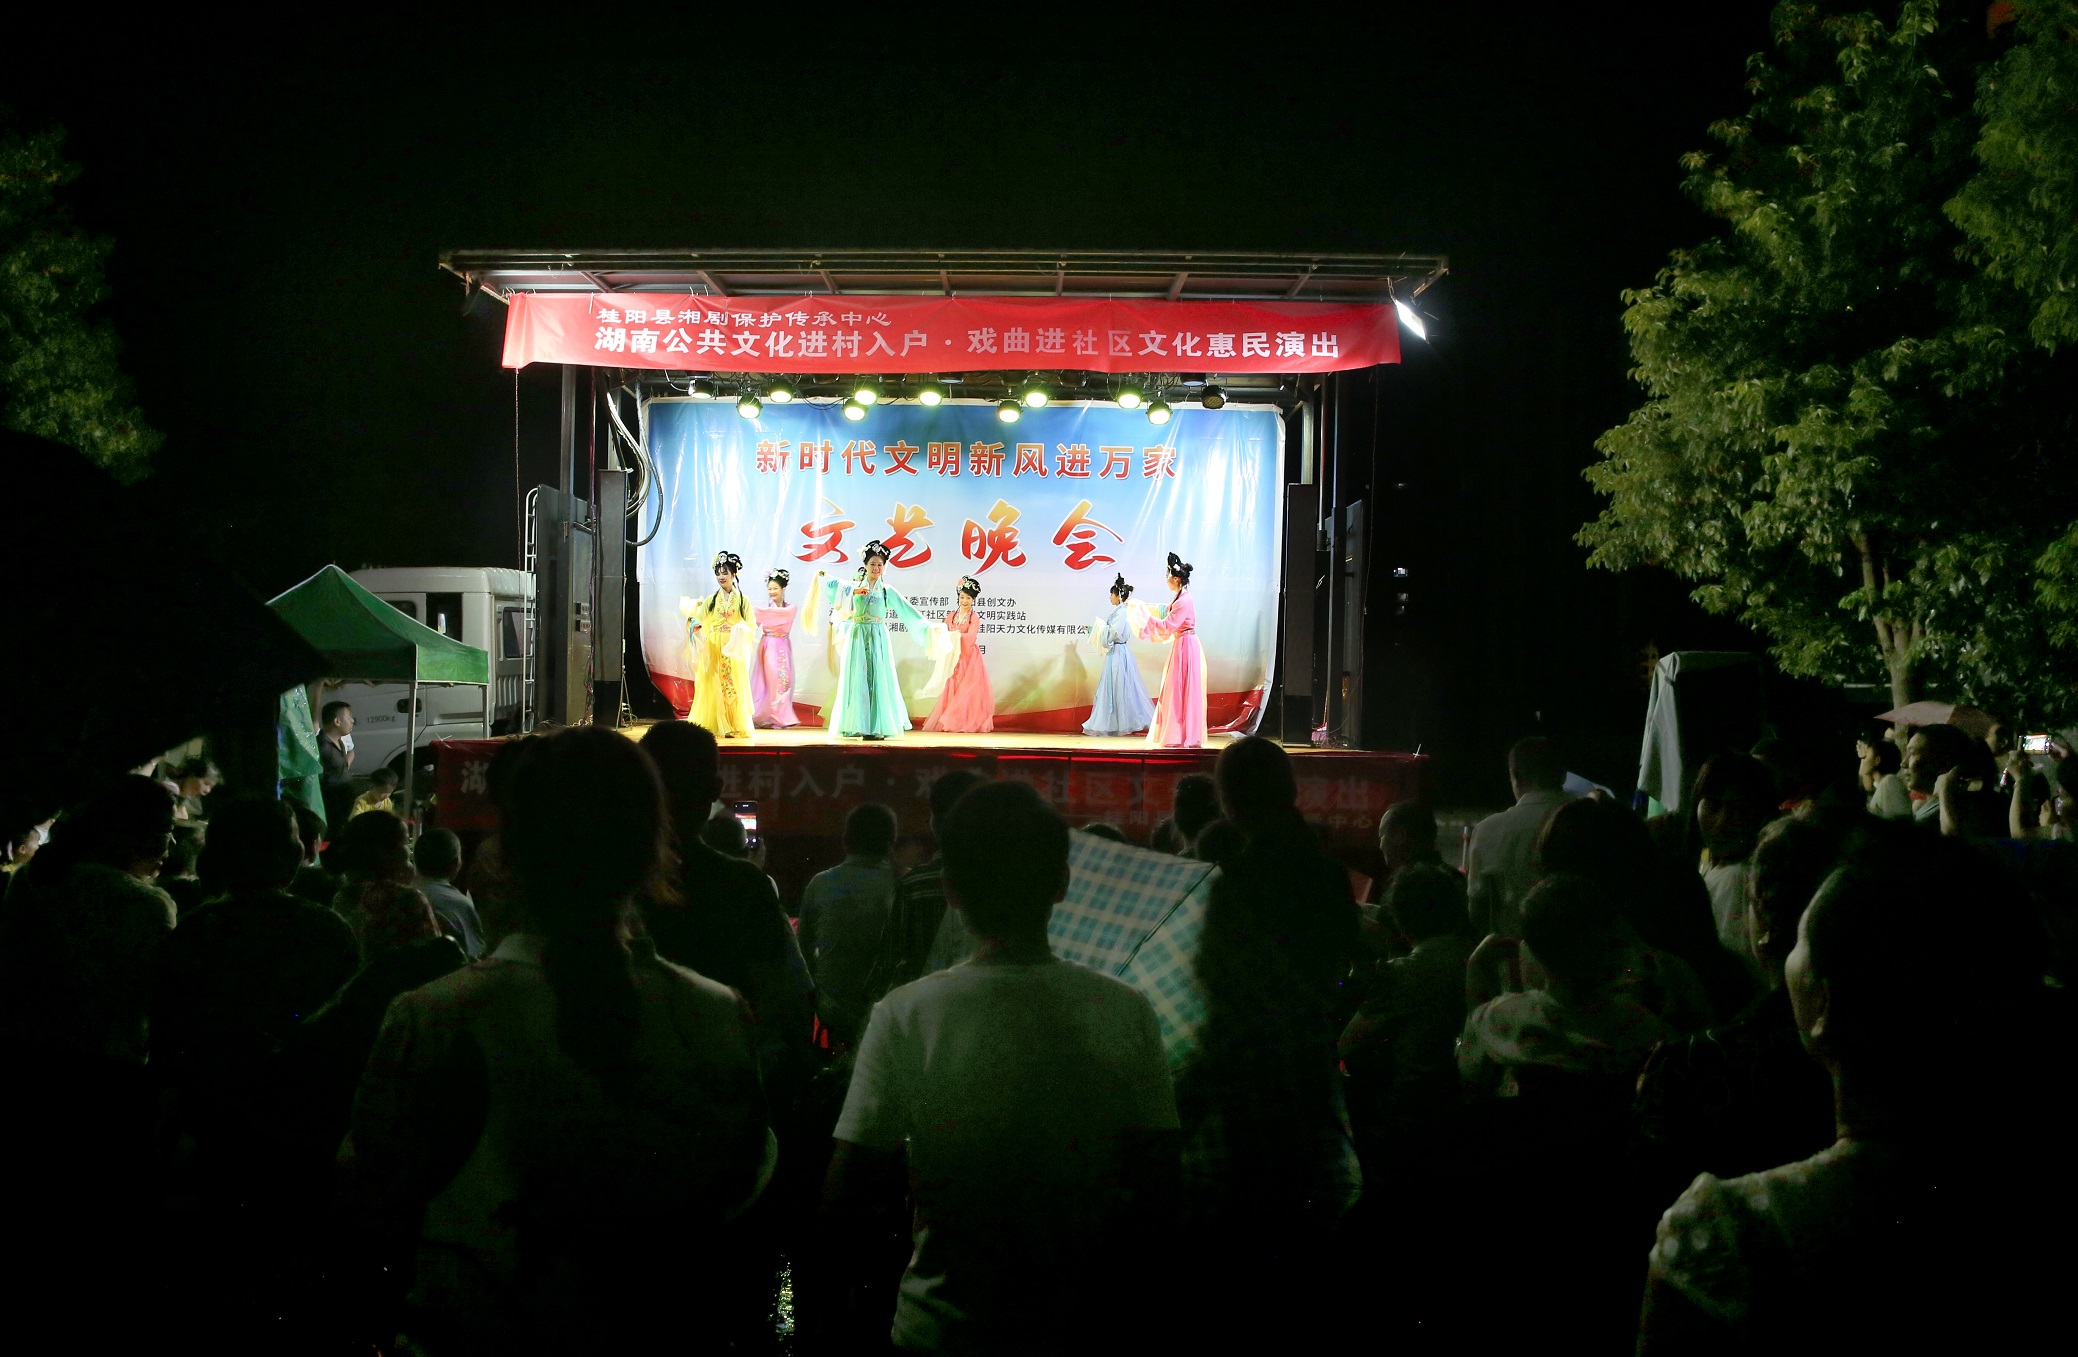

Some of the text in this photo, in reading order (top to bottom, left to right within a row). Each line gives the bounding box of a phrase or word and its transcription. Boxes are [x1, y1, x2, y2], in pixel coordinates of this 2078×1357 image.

[596, 307, 893, 327] 桂阳县湘剧保护传承中心
[755, 440, 1179, 481] 新时代文明新风进万家
[789, 496, 1125, 575] 文艺晚会
[905, 596, 1017, 608] 委宣传部 县创文办
[977, 623, 1090, 636] 桂阳天力文化传媒有限公
